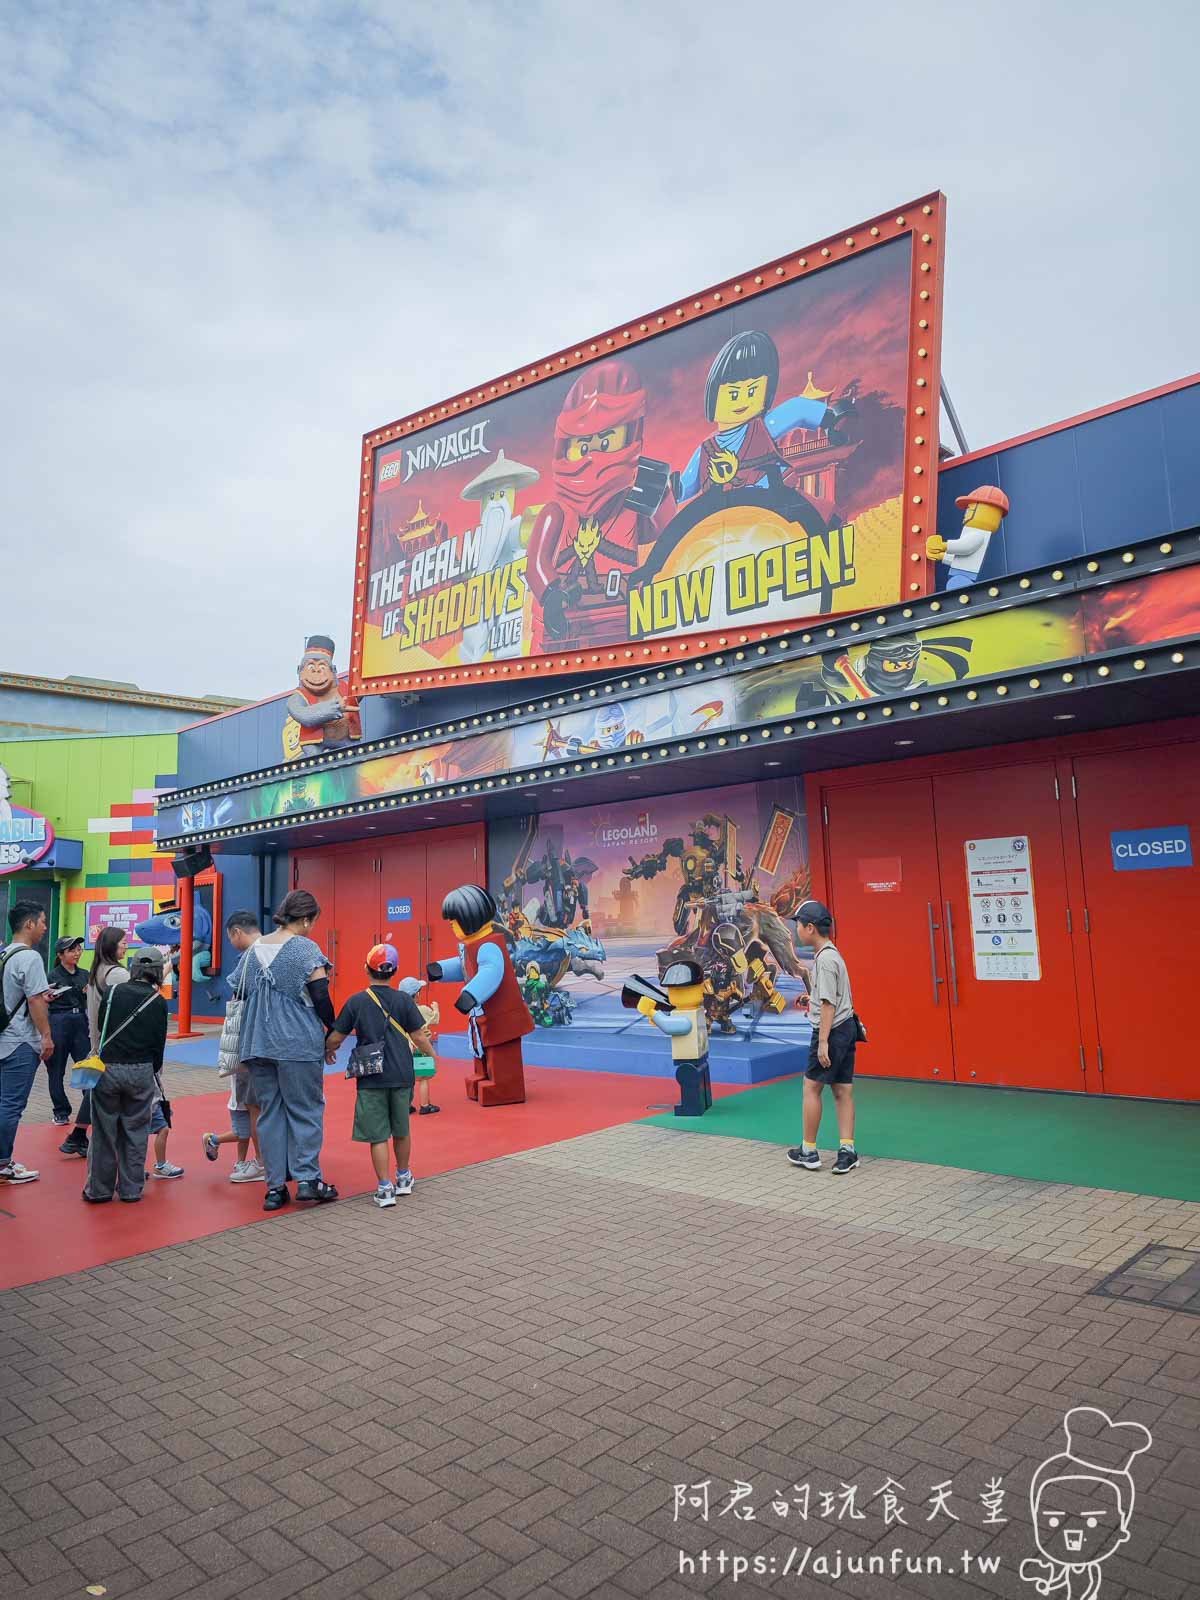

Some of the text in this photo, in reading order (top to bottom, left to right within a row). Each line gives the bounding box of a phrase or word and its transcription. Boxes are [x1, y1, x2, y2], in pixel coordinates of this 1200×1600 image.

[382, 419, 491, 483] LEGO NINJAGO
[370, 525, 482, 611] THE REALM
[629, 524, 856, 637] NOW OPEN!
[382, 556, 528, 650] OF SHADOWS
[489, 617, 522, 650] LIVE
[602, 813, 658, 841] LEGOLAND
[1115, 839, 1187, 858] CLOSED
[388, 905, 411, 914] CLOSED
